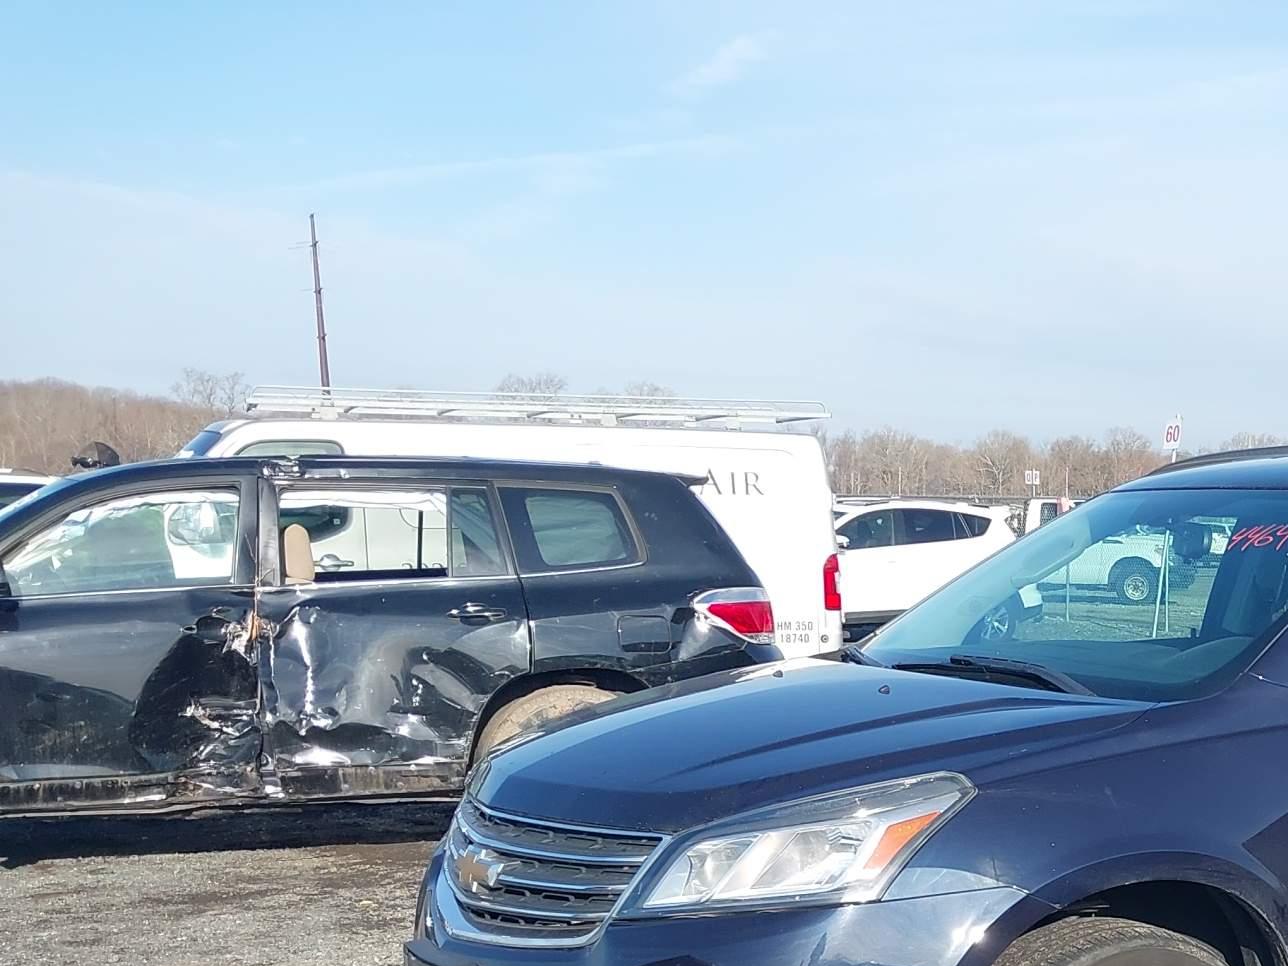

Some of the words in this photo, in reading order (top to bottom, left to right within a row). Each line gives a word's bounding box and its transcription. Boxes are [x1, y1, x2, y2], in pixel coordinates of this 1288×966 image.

[1165, 424, 1180, 443] 60
[700, 468, 765, 496] AIR
[776, 620, 792, 631] HM
[795, 620, 814, 631] 350
[780, 633, 810, 644] 18740
